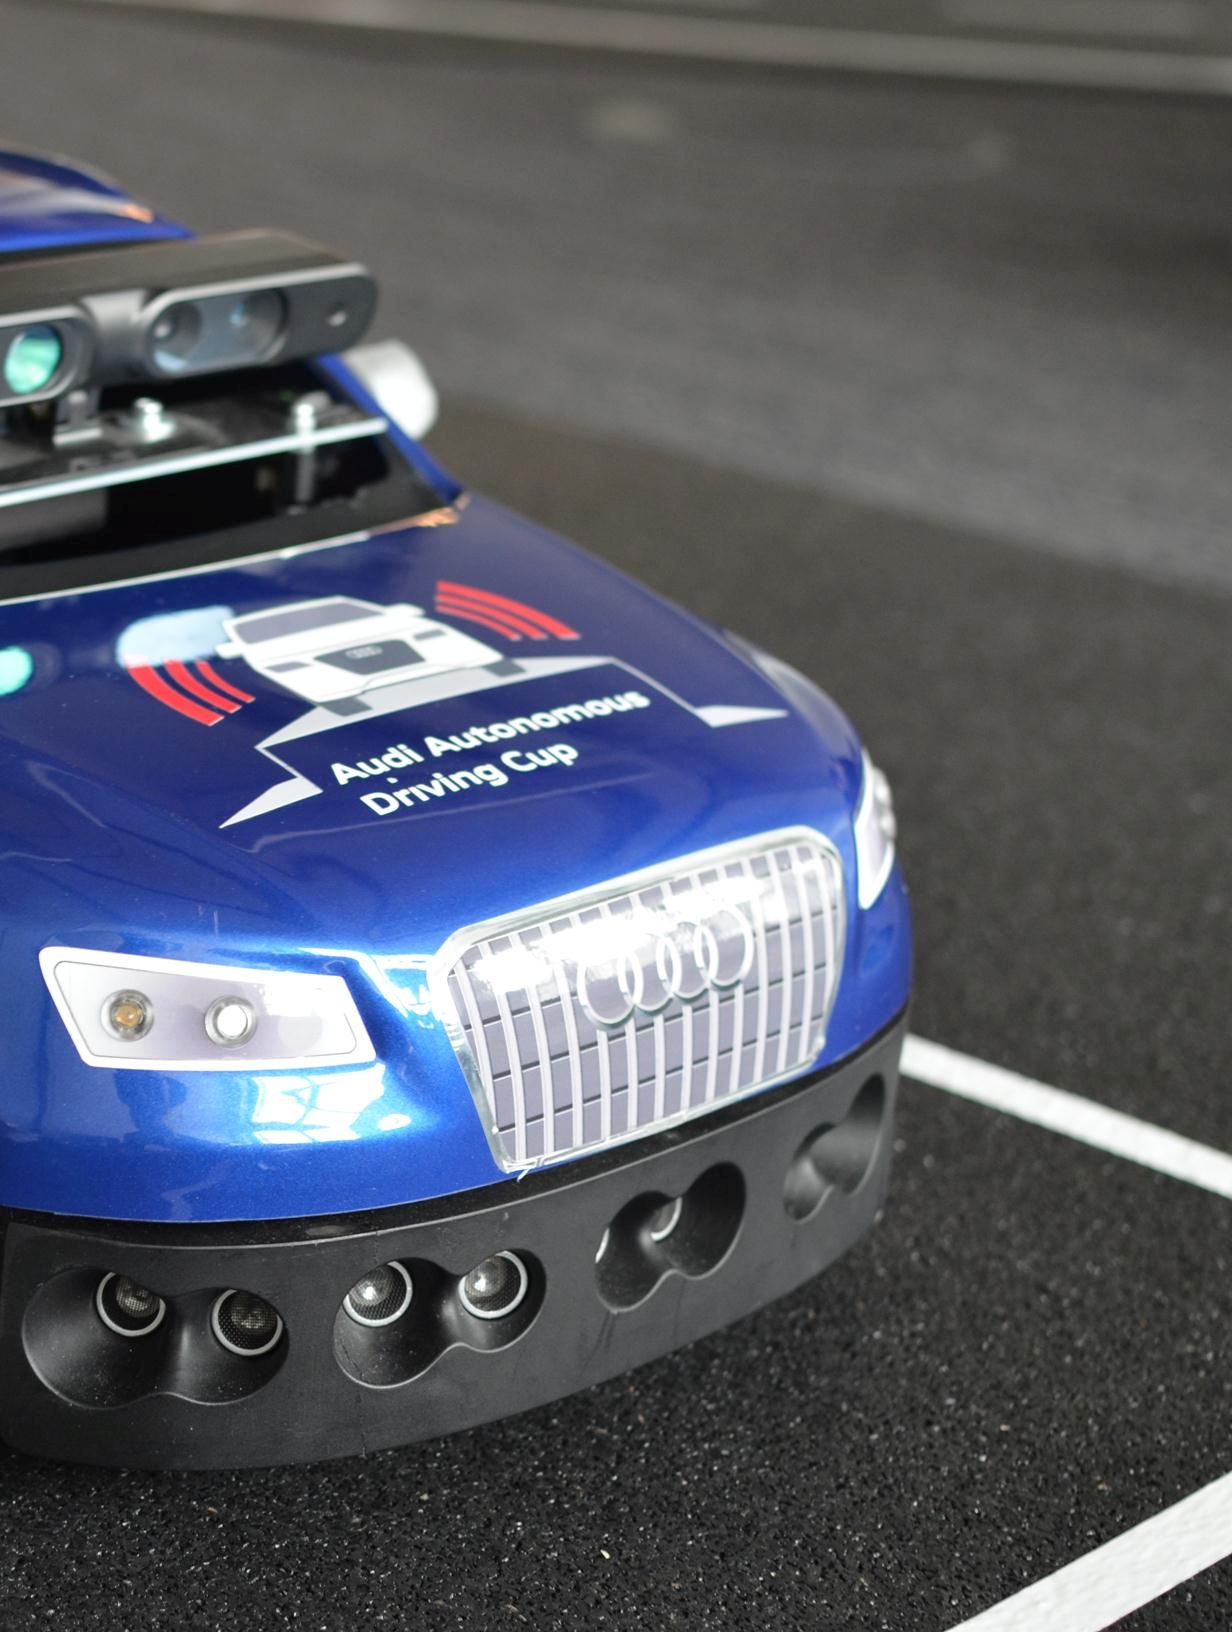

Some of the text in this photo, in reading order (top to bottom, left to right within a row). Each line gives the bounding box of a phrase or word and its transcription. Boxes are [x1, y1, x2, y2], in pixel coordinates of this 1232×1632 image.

[330, 691, 651, 786] Audi Autonomous
[359, 743, 579, 816] Driving Cup
